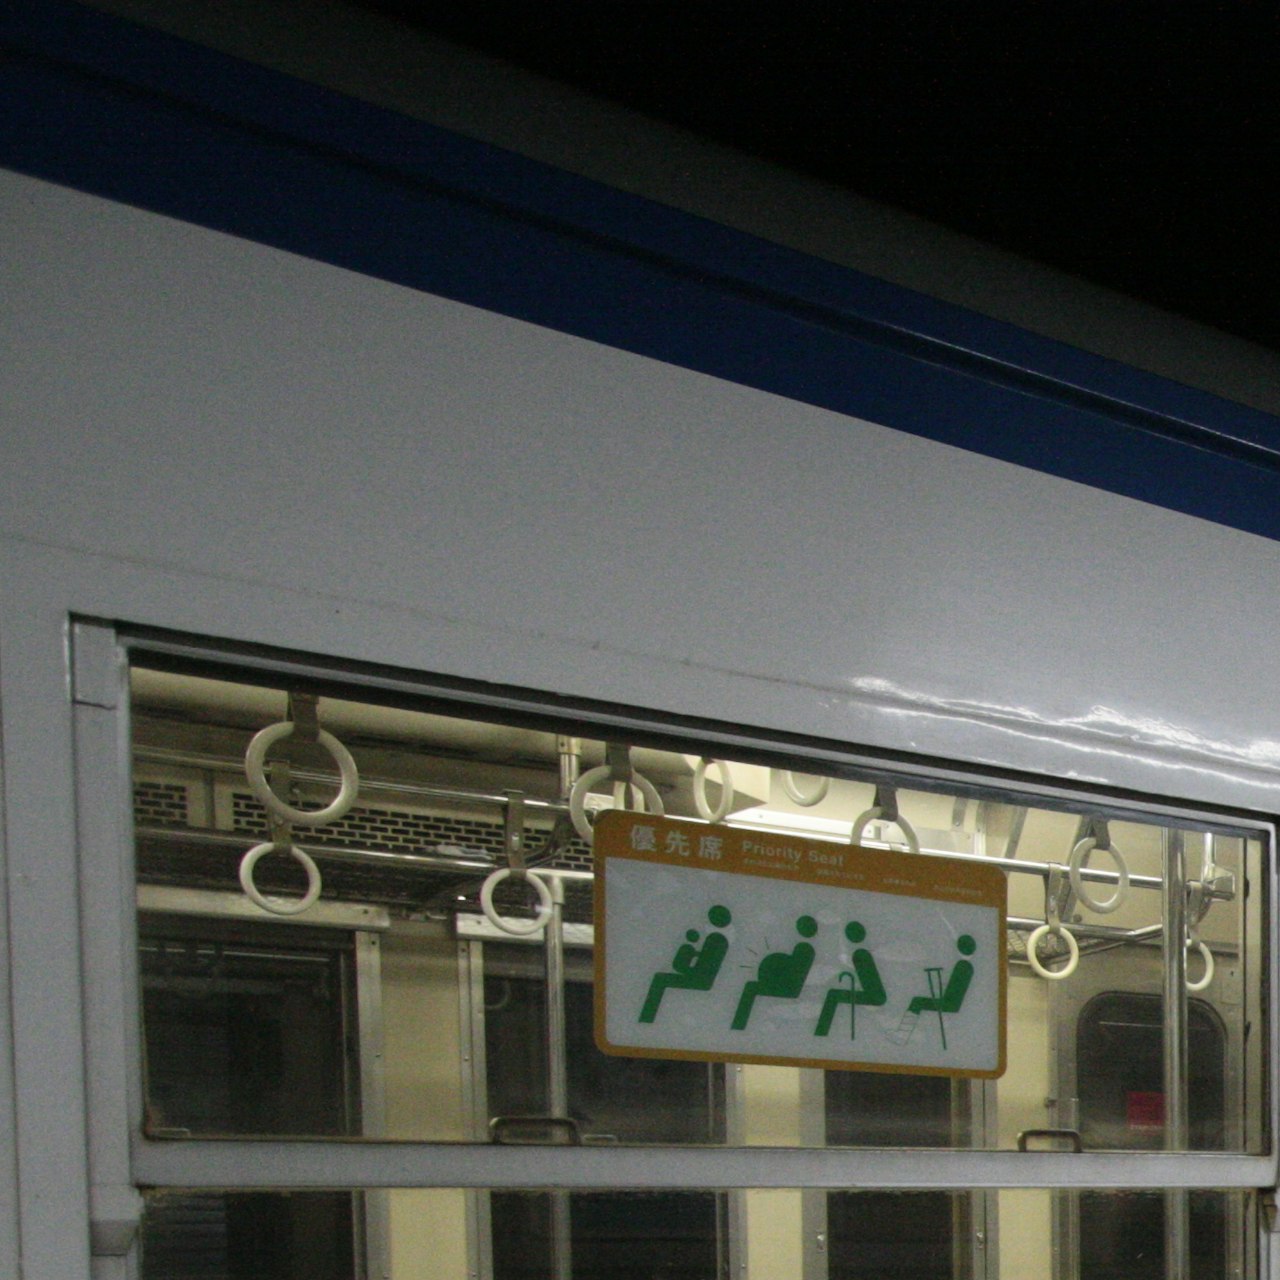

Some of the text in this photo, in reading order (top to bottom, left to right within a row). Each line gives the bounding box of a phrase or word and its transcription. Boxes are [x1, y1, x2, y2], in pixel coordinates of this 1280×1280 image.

[631, 825, 723, 860] 優先席
[742, 840, 801, 862] Priority
[808, 850, 844, 867] Seat
